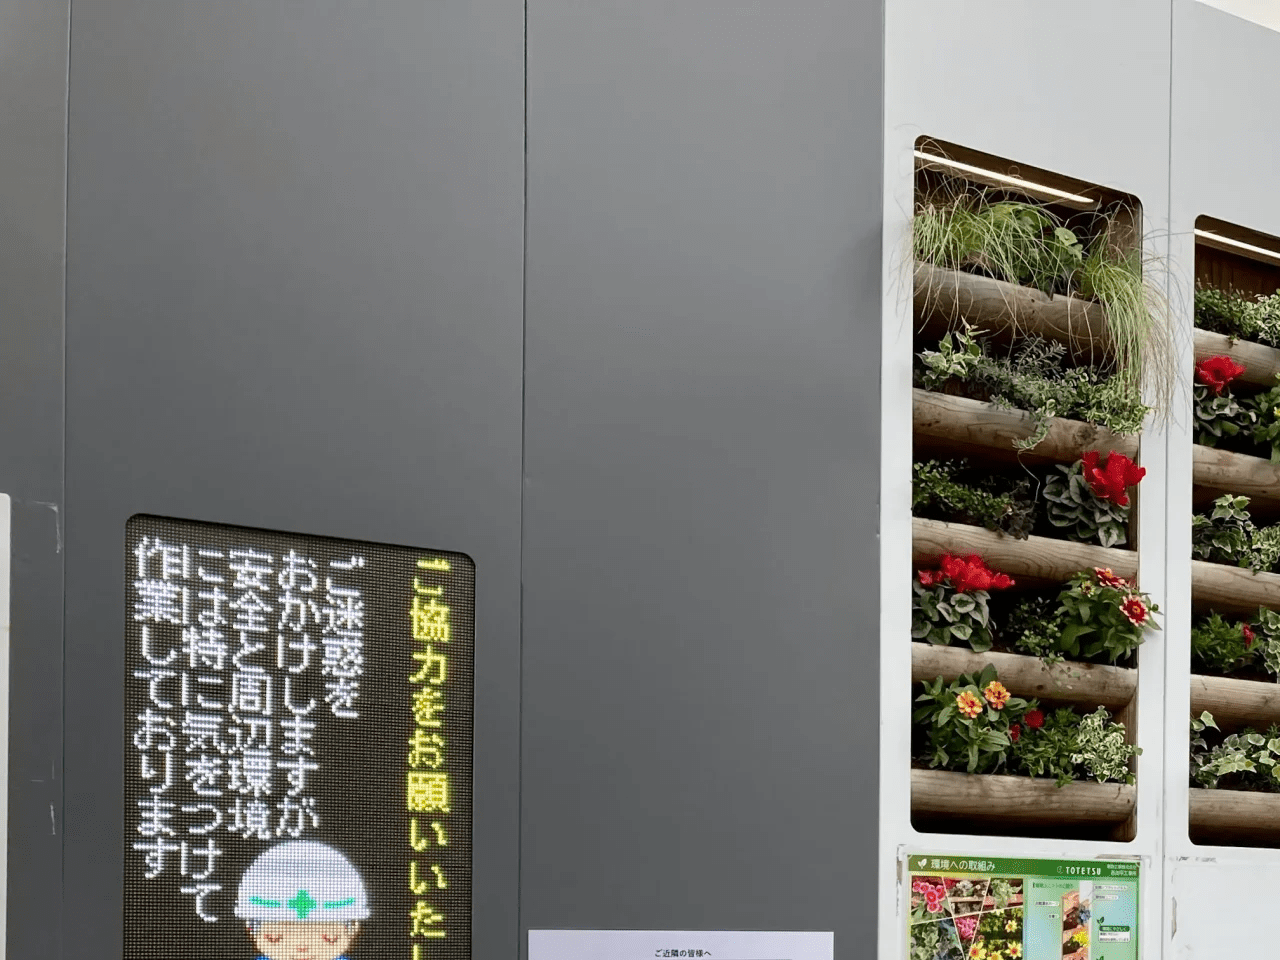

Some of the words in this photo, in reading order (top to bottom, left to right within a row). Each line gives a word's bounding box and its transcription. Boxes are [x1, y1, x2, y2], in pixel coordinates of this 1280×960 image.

[133, 536, 181, 879] 作業しております
[180, 544, 228, 922] には特に気をつけて
[228, 548, 274, 840] 安全と周辺環境
[276, 549, 319, 839] おかけしますが
[322, 556, 365, 718] ご迷惑を
[655, 948, 712, 958] ご近隣の皆様へ
[931, 858, 995, 872] 環境への取組み
[1066, 866, 1101, 876] TOTETSU
